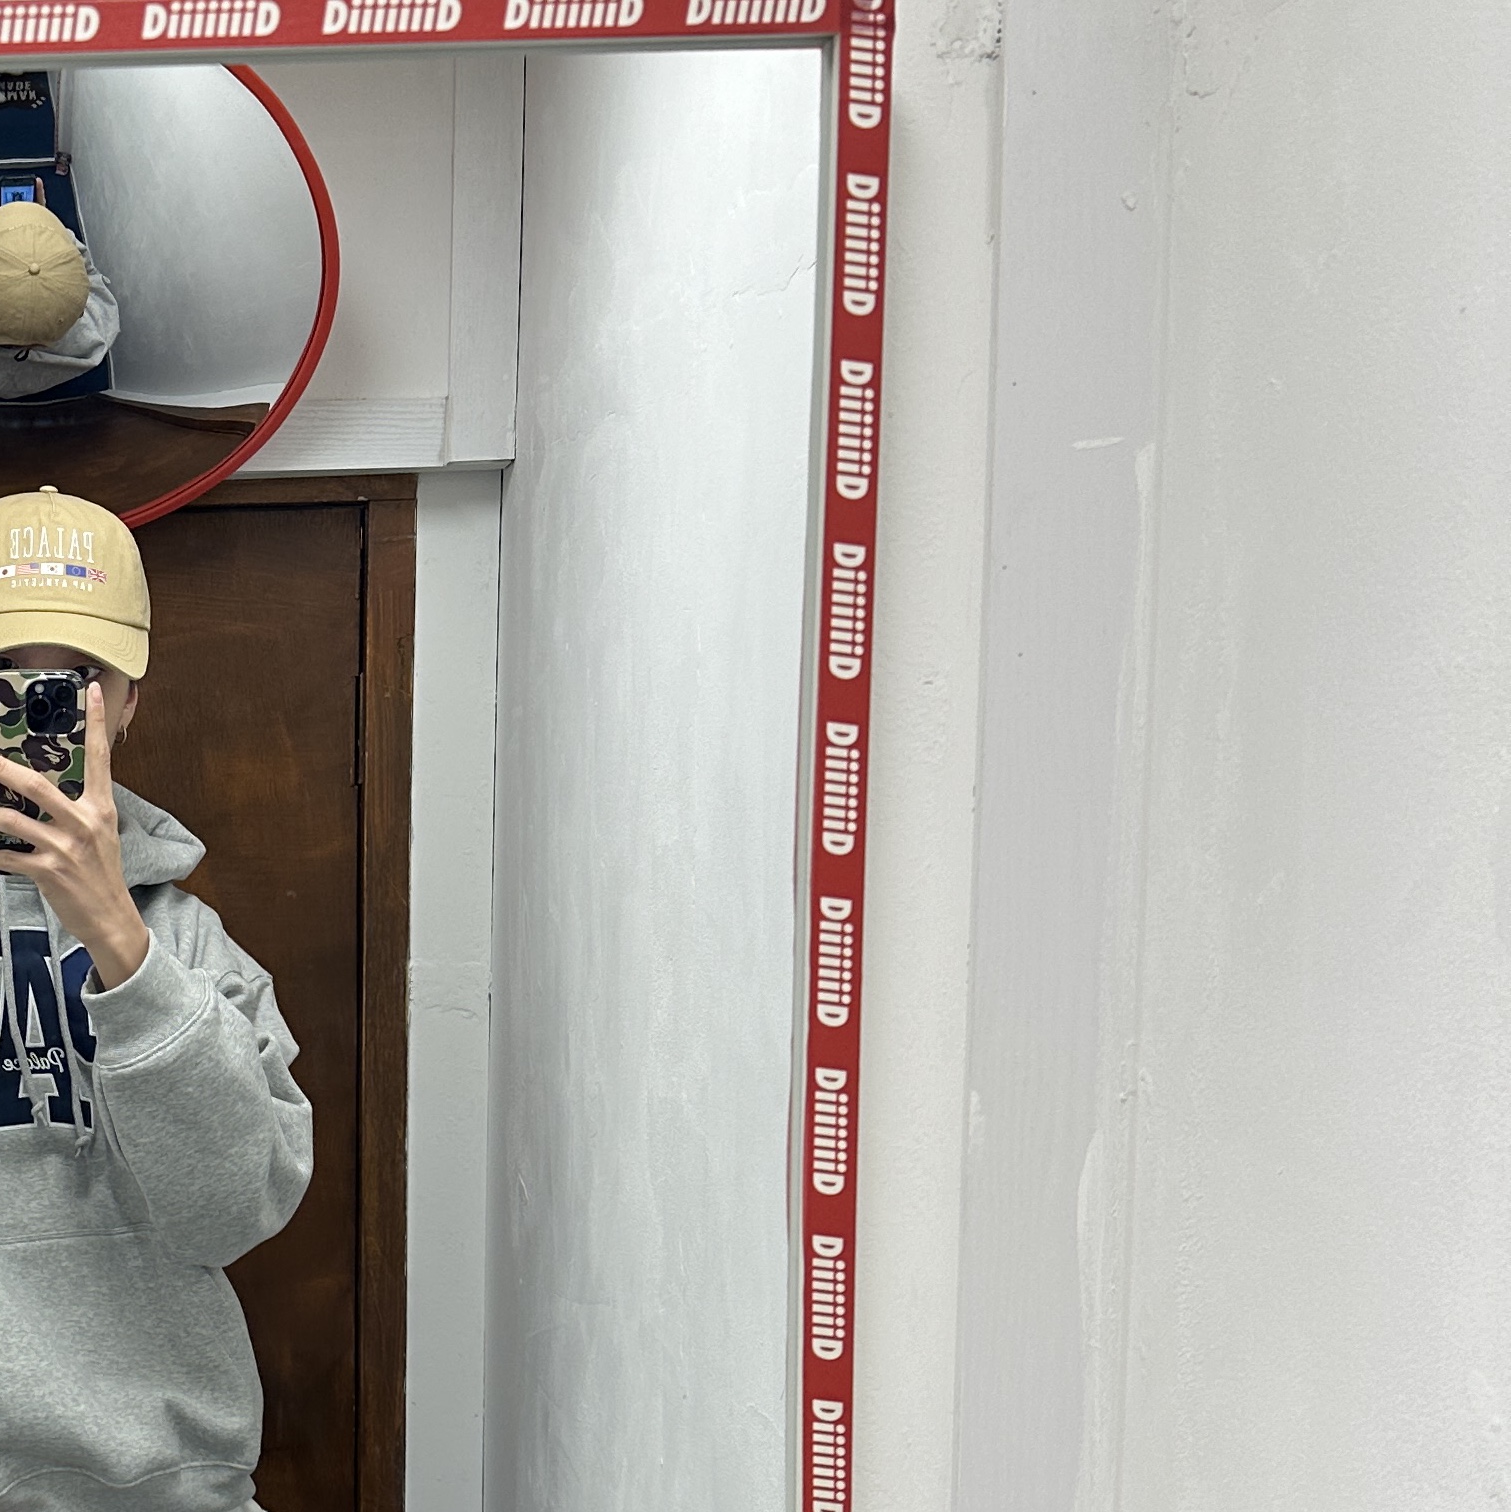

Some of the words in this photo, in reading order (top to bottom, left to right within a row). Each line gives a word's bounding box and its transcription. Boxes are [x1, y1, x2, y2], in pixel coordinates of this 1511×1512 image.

[141, 0, 281, 40] DiiiiiiiD
[843, 173, 881, 315] DiiiiiiiD
[836, 359, 875, 499] DiiiiiiiD
[829, 542, 867, 679] DiiiiiiiD
[822, 722, 860, 855] DiiiiiiiD
[817, 896, 853, 1027] DiiiiiiiD
[813, 1067, 848, 1195] DiiiiiiiD
[812, 1235, 845, 1360] DiiiiiiiD
